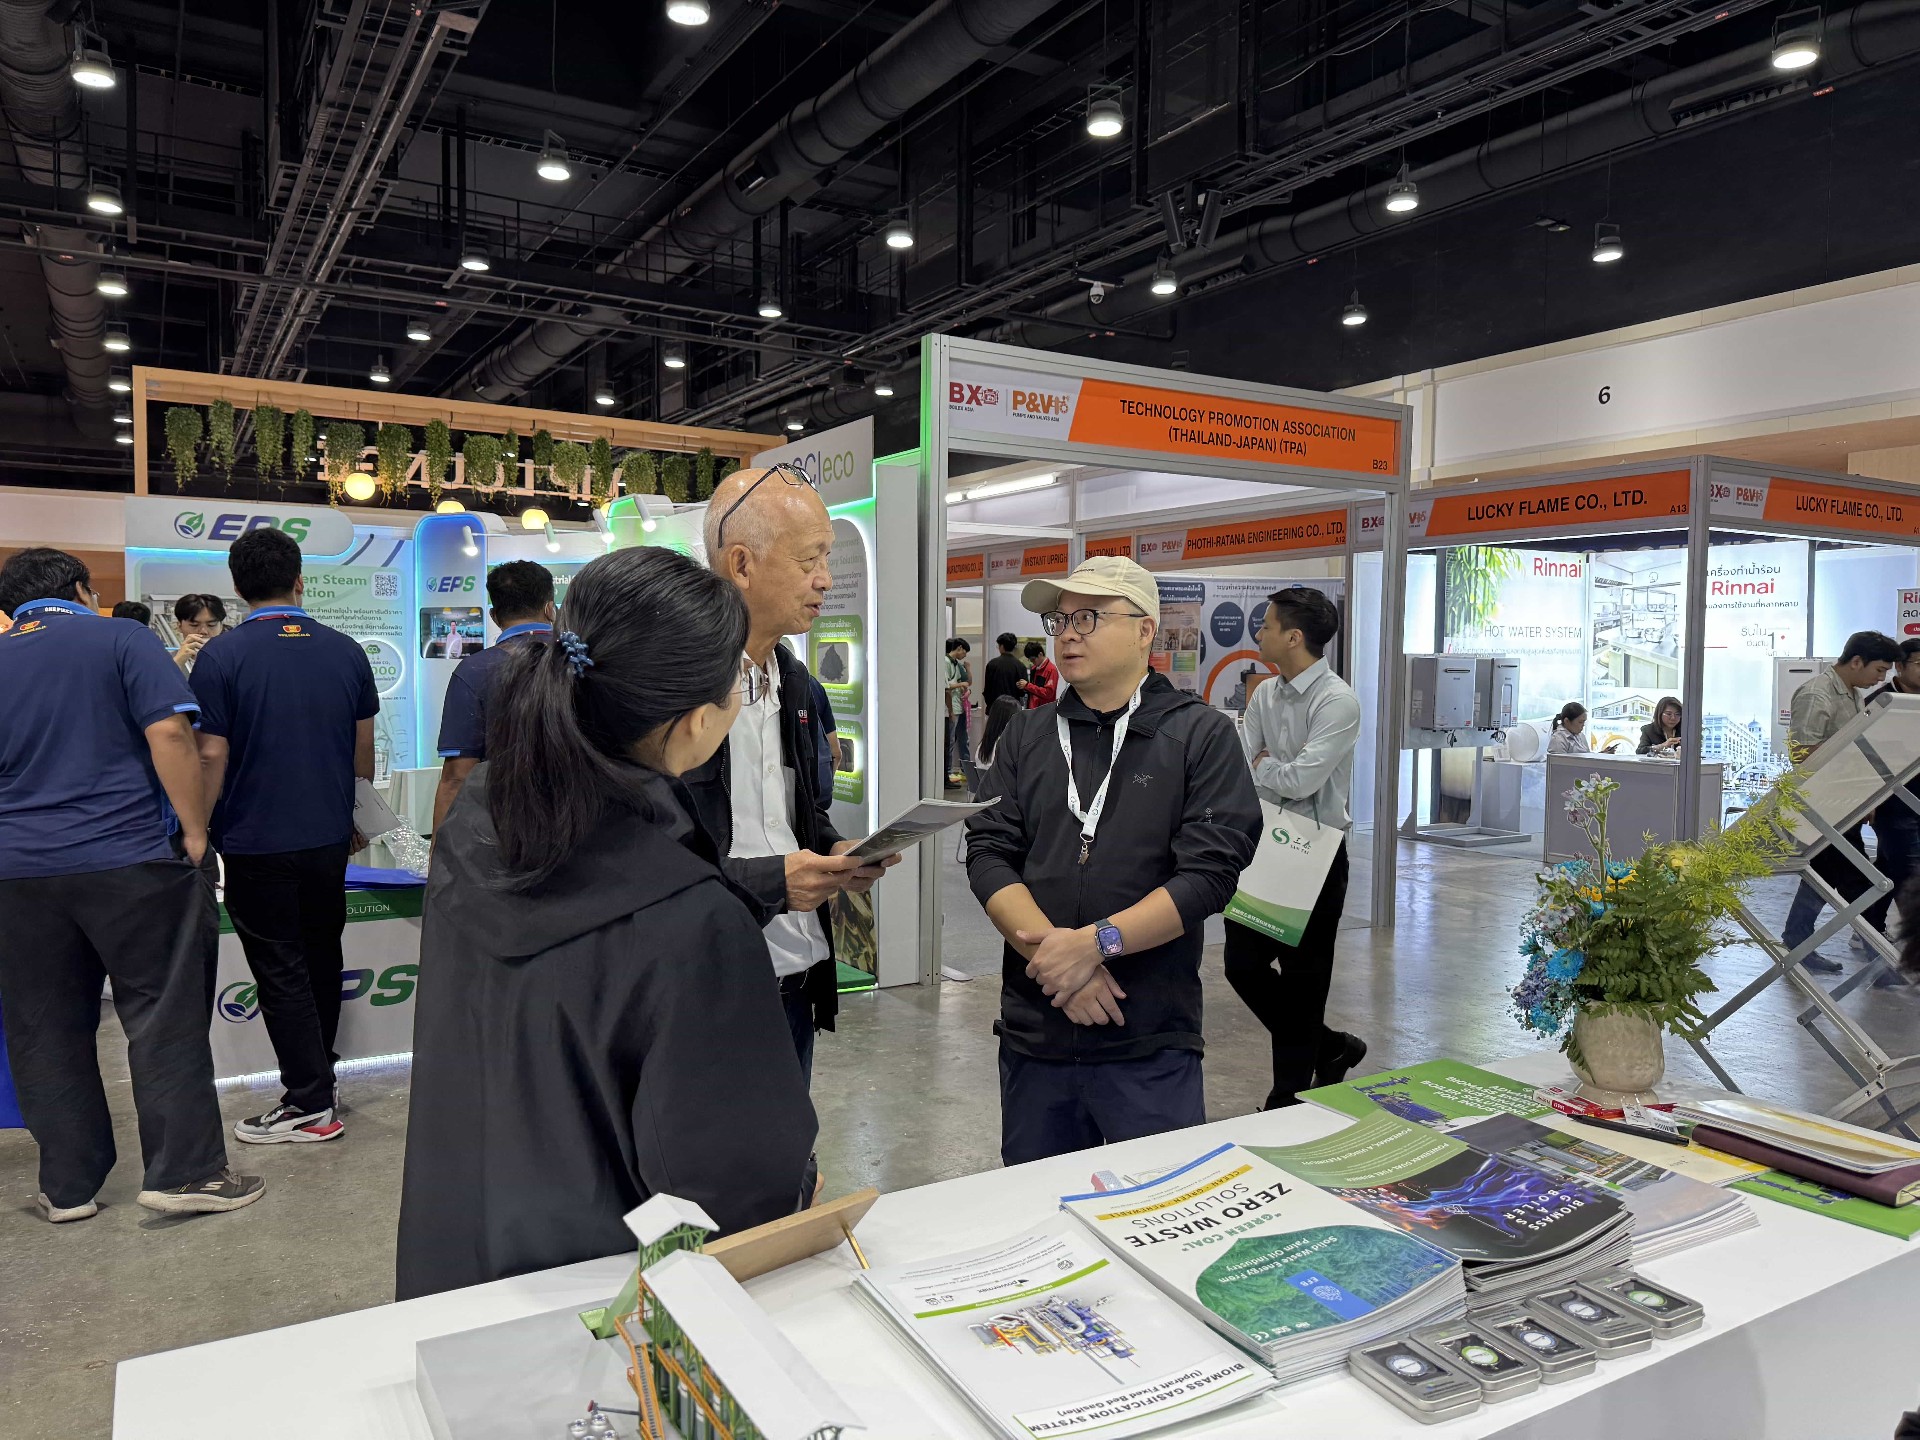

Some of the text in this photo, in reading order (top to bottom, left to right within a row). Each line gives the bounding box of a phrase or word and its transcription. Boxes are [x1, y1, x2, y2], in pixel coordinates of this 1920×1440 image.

[1597, 385, 1611, 405] 6
[1119, 399, 1356, 442] TECHNOLOGY PROMOTION ASSOCIATION
[1168, 425, 1307, 457] (THAILAND-JAPAN) (TPA)
[1372, 459, 1388, 471] B23
[1467, 489, 1648, 521] LUCKY FLAME CO., LTD.
[1669, 503, 1687, 514] A13
[1795, 495, 1904, 523] LUCKY FLAME CO., LTD.
[1186, 533, 1245, 551] PHOTHI-RATANA
[1247, 526, 1304, 544] ENGINEERING
[1326, 521, 1345, 535] LTD.
[1334, 536, 1346, 544] A12
[1533, 557, 1582, 579] Rinnai
[322, 573, 367, 586] Steam
[437, 575, 476, 593] EPS
[1711, 578, 1775, 596] Rinnai
[57, 606, 74, 615] PIECE
[1484, 625, 1582, 639] HOT WATER SYSTEM
[346, 903, 390, 915] OLUTION
[1212, 1169, 1241, 1186] CLEAN
[1131, 1182, 1250, 1229] SOLUTIONS
[1174, 1186, 1204, 1203] GREEN
[1221, 1181, 1292, 1219] ZERO
[1503, 1189, 1560, 1220] BOILER
[1109, 1202, 1166, 1219] RENEWABLE
[1528, 1199, 1585, 1231] BIOMASS
[1124, 1215, 1223, 1248] WASTE
[1218, 1235, 1338, 1283] Solid Waste Energy From
[1225, 1237, 1310, 1272] Palm Oil Industry
[1299, 1275, 1319, 1287] EFB
[1028, 1363, 1246, 1432] BIOMASS GASIFICATION SYSTEM
[1057, 1369, 1203, 1417] (Updraft Fixed Bed Gasifier)
